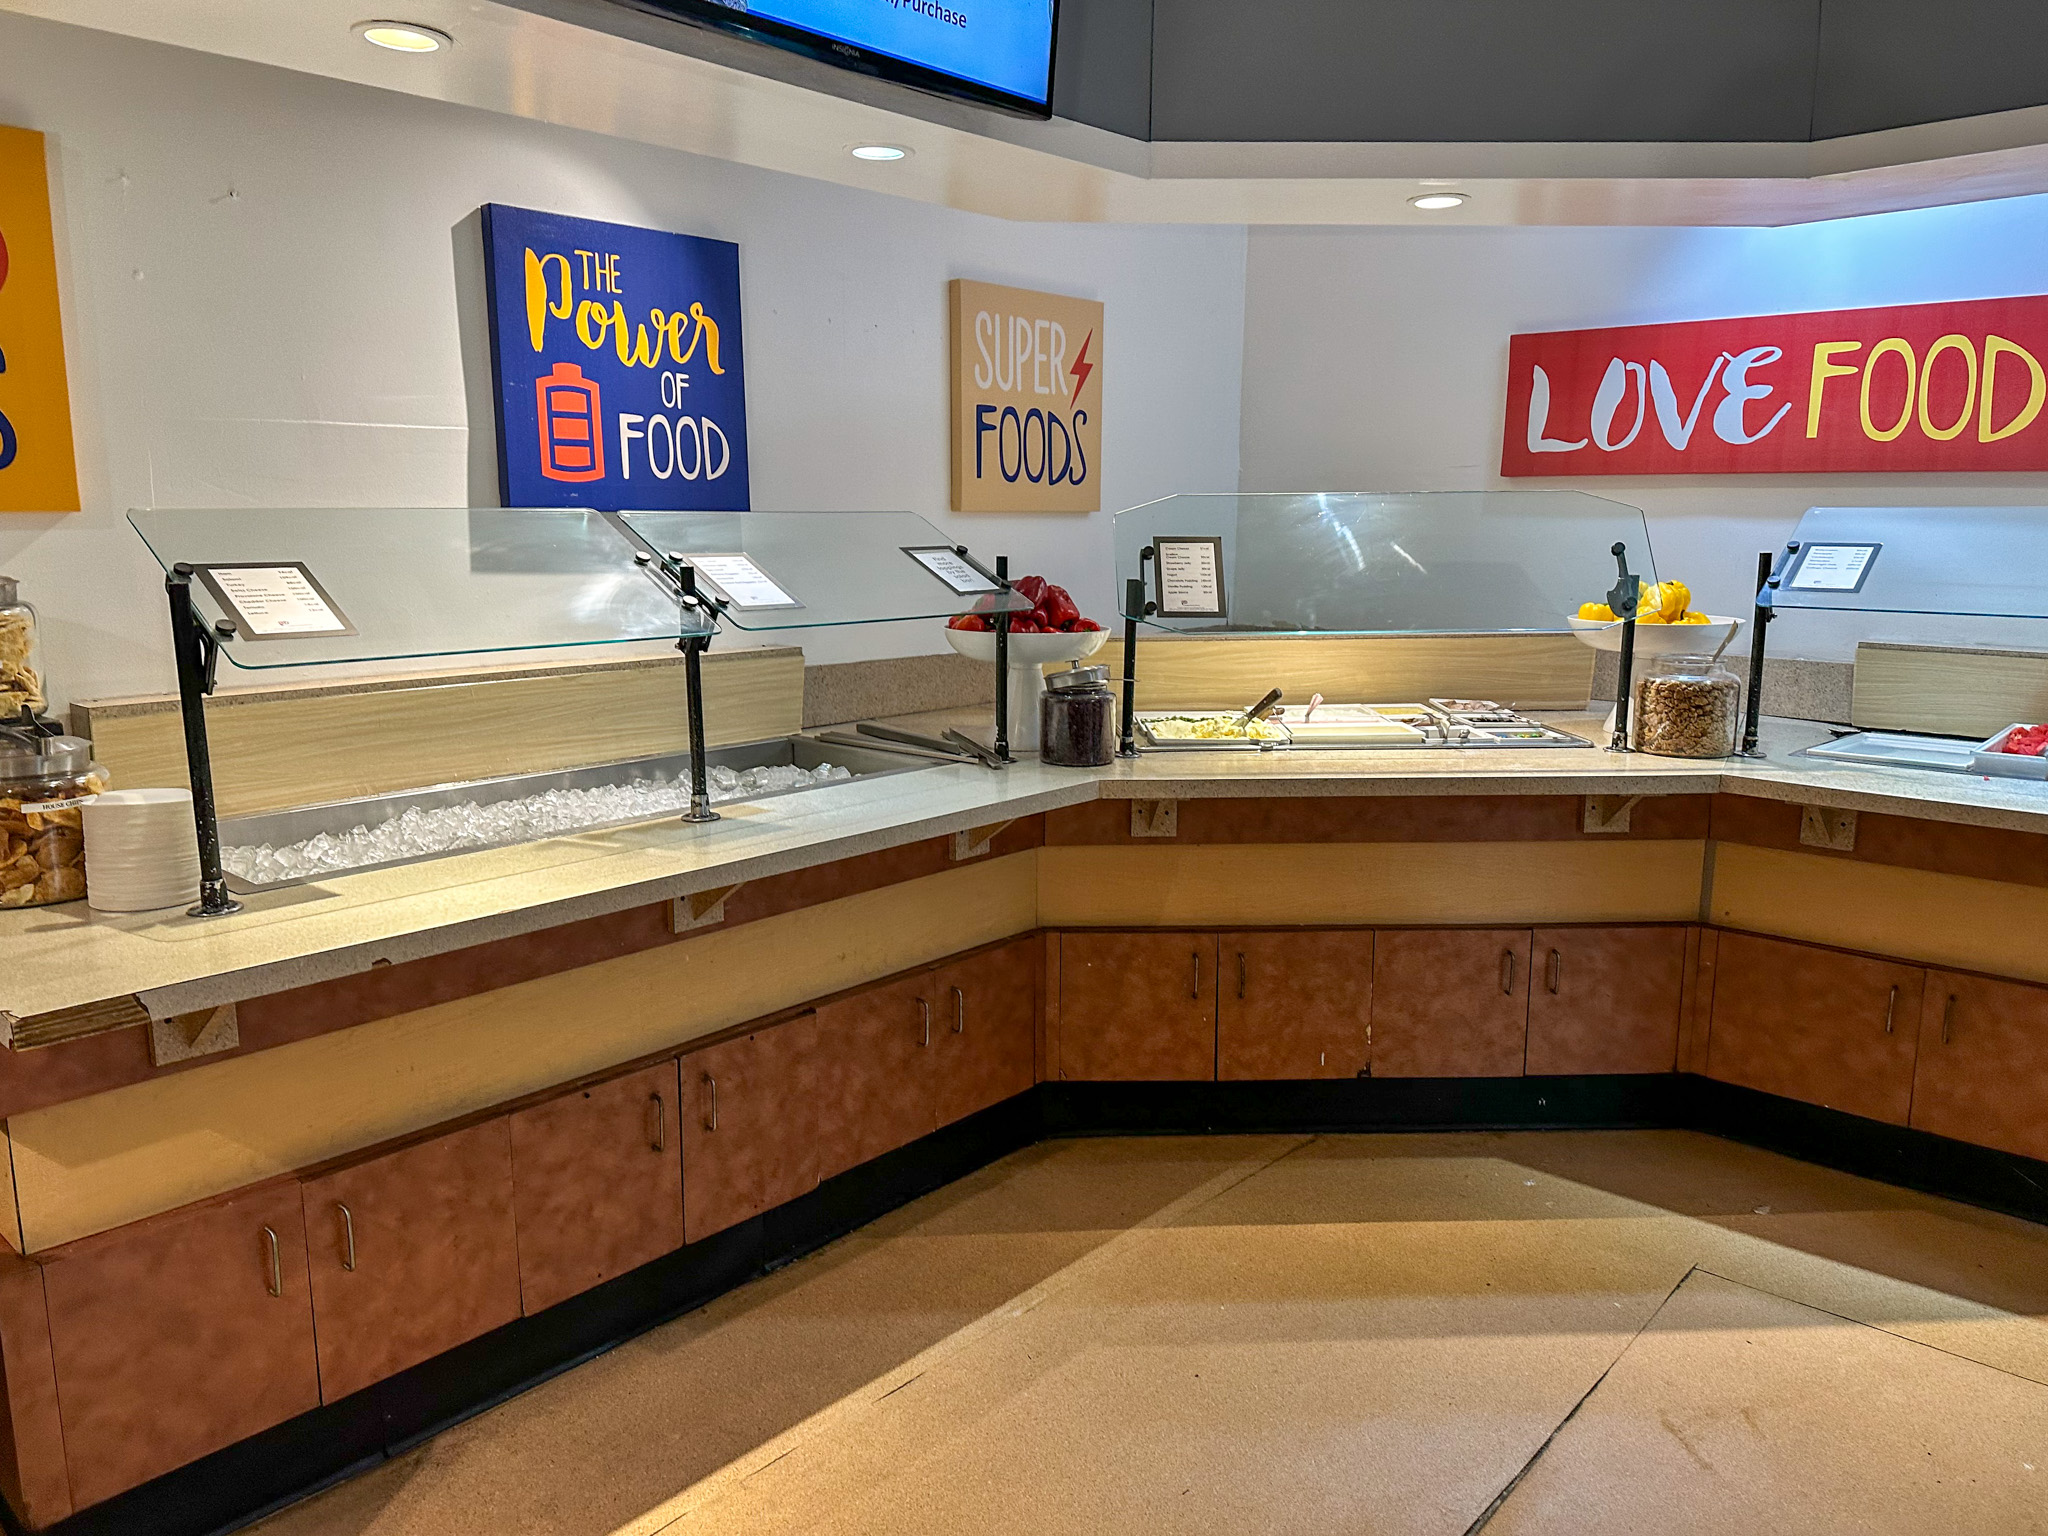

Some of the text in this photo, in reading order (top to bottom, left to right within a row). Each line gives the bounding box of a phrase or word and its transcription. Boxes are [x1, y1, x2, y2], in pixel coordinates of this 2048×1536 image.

[885, 0, 967, 29] urchase
[574, 249, 623, 294] THE
[974, 310, 1069, 396] SUPER
[660, 371, 690, 410] OF
[1527, 334, 2047, 453] LOVE FOOD
[619, 413, 730, 481] FOOD
[976, 404, 1088, 486] FOODS
